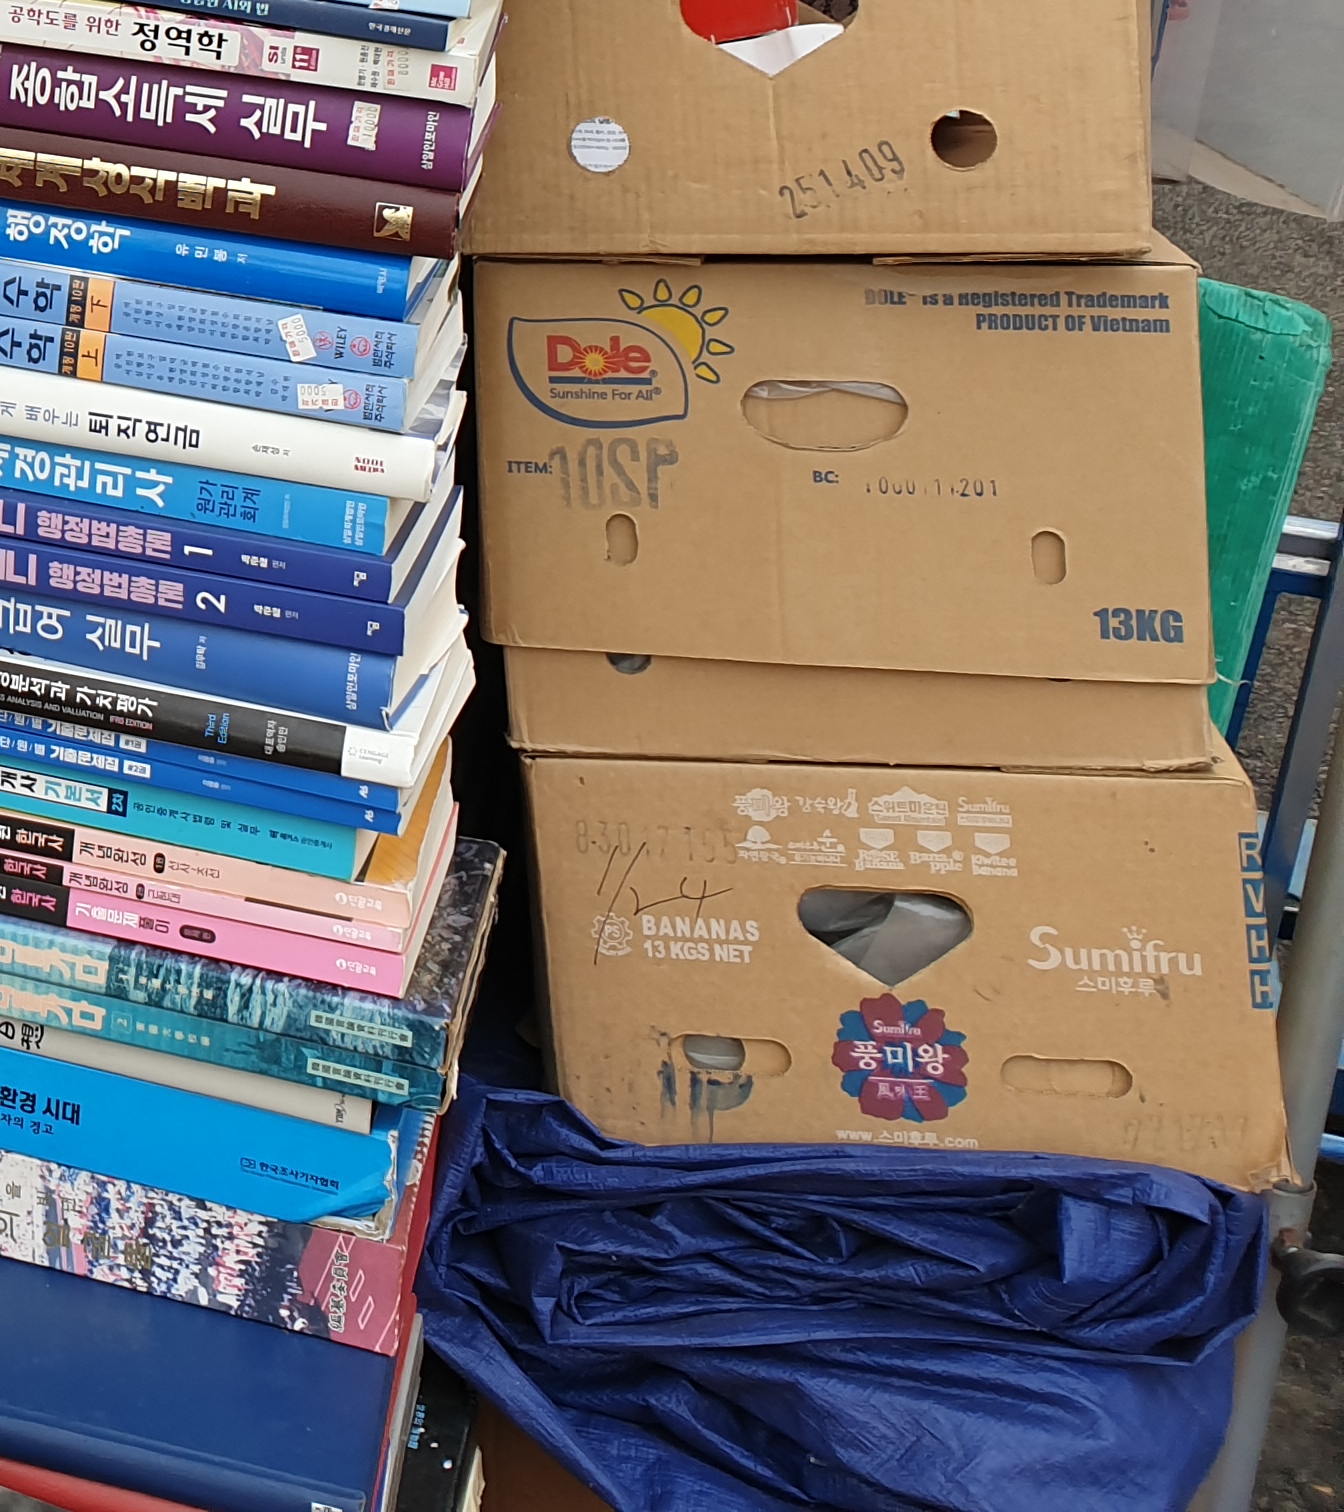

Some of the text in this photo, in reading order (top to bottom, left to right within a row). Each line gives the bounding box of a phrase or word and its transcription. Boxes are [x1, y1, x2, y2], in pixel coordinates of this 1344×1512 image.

[131, 21, 228, 60] 정역학
[9, 61, 328, 148] 종합소득세 실무
[1065, 290, 1171, 310] Trademark
[976, 312, 1171, 334] PRODUCT Vietnam
[334, 325, 348, 359] WILEY
[546, 335, 654, 379] Dole
[549, 387, 635, 402] Sunshine For
[87, 413, 200, 450] 퇴직연금
[812, 469, 840, 484] BC:
[37, 510, 173, 558] 행정법총론
[49, 561, 185, 608] 행정법총론
[196, 591, 225, 614] 2
[85, 614, 160, 660] 실무
[1093, 605, 1184, 645] 13KG
[76, 684, 158, 718] 가치평가
[43, 779, 109, 809] 기본서
[642, 915, 760, 943] BANANAS
[644, 939, 752, 963] 13 KGS NET
[1028, 924, 1202, 977] Sumifru
[1074, 975, 1157, 996] 스미후루
[873, 1020, 921, 1036] Sumifru
[850, 1040, 949, 1075] 풍미왕
[42, 1096, 80, 1125] 시대
